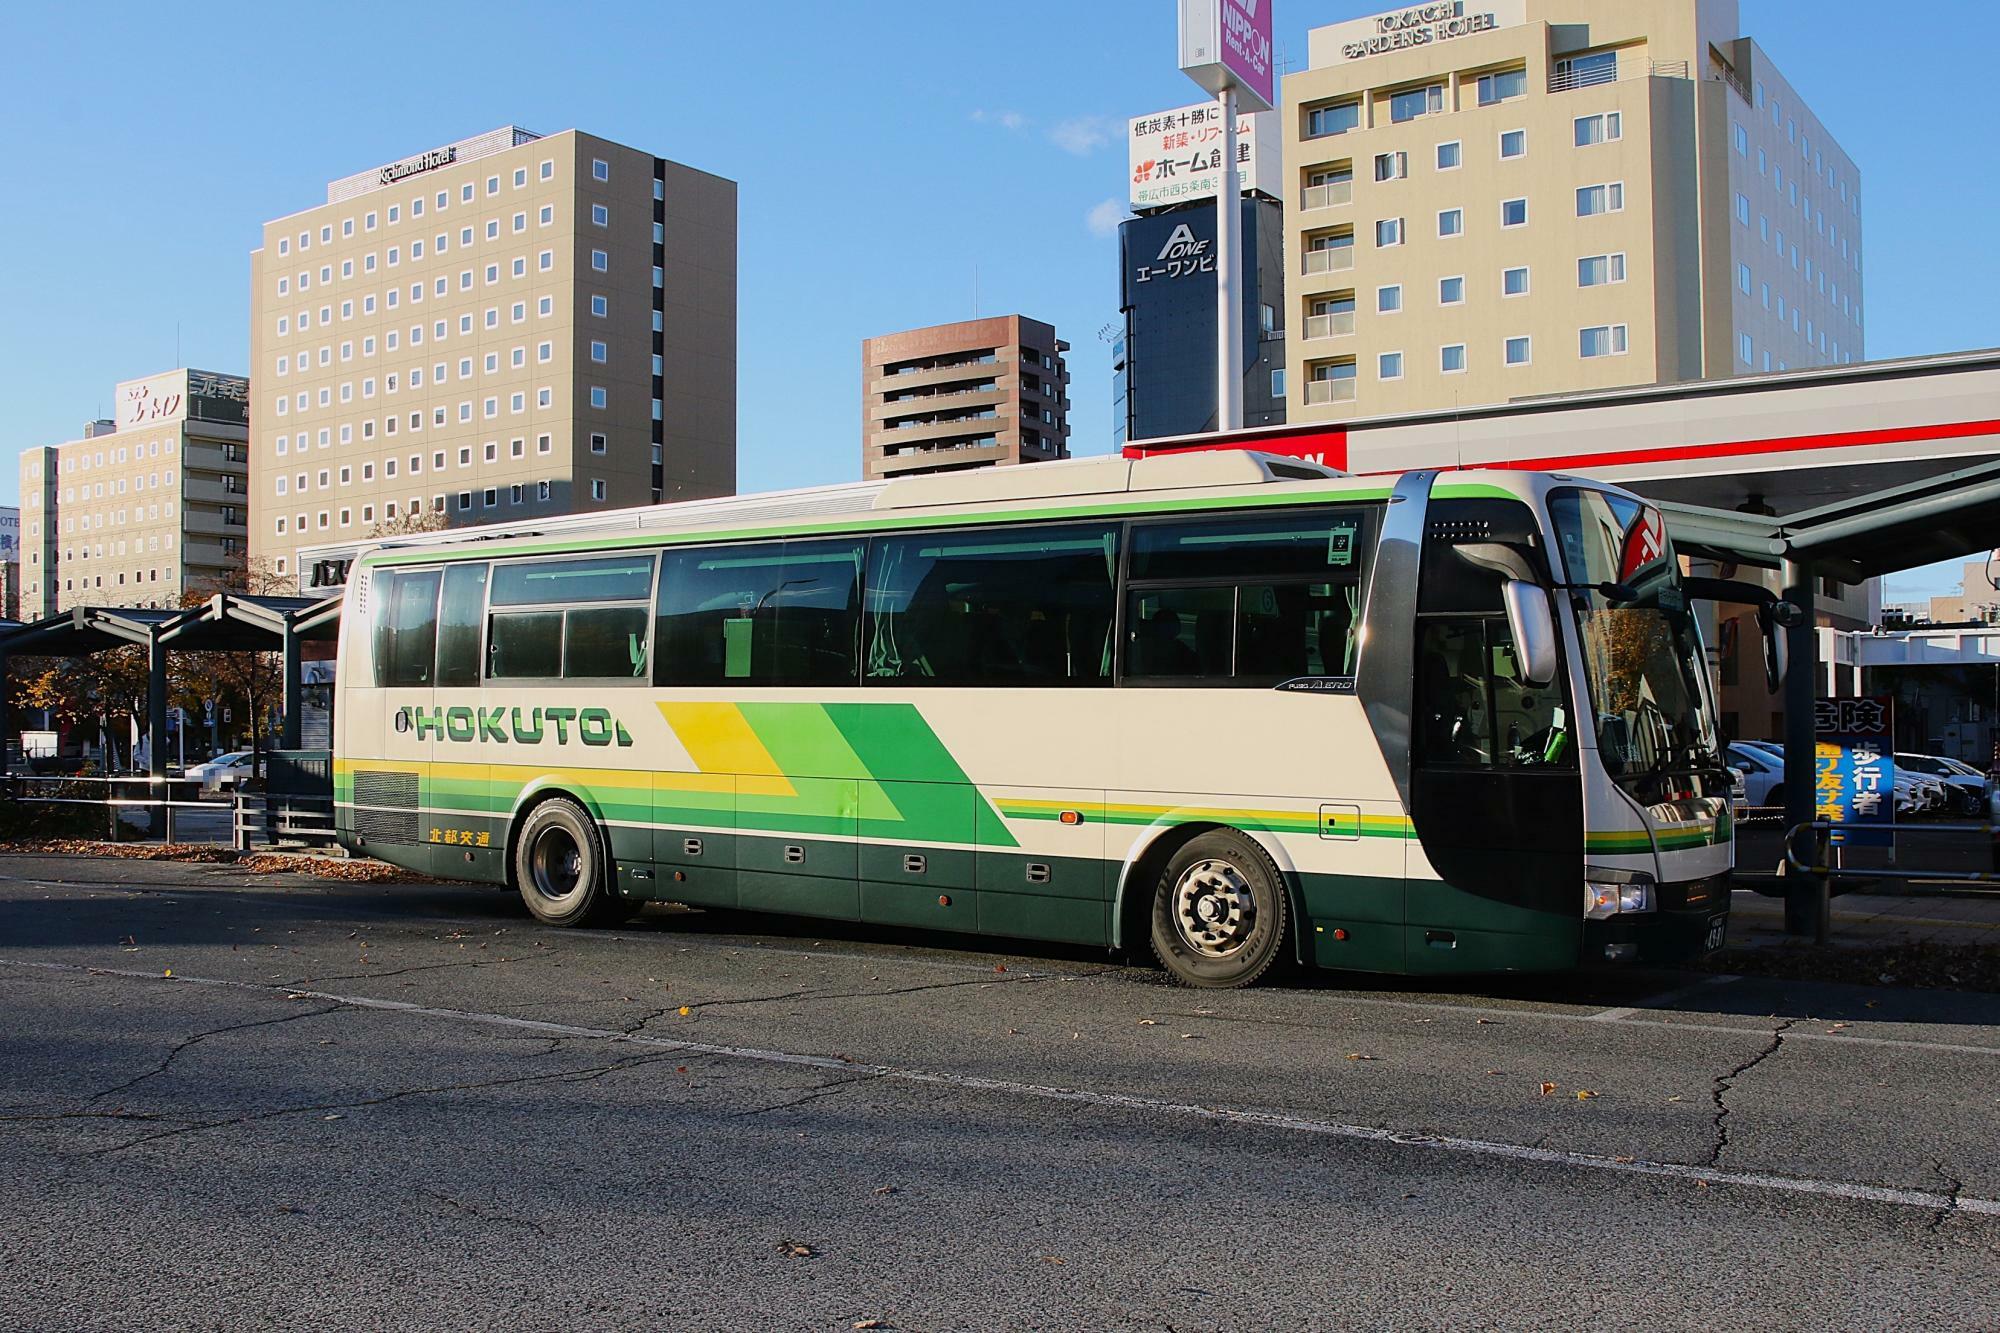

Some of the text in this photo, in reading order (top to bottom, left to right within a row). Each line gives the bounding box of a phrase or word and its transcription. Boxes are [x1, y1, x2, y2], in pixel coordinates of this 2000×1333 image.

[1223, 0, 1269, 65] NIPPON
[1376, 1, 1456, 33] TOKACHI
[1342, 12, 1491, 58] GARDENS HOTEL
[1135, 107, 1219, 137] 低炭素十勝に
[1136, 253, 1218, 283] エーワンビ
[1310, 680, 1352, 689] AERO
[415, 706, 613, 747] HOKUTO
[1851, 741, 1882, 816] 歩行者
[430, 828, 490, 847] 北都交通
